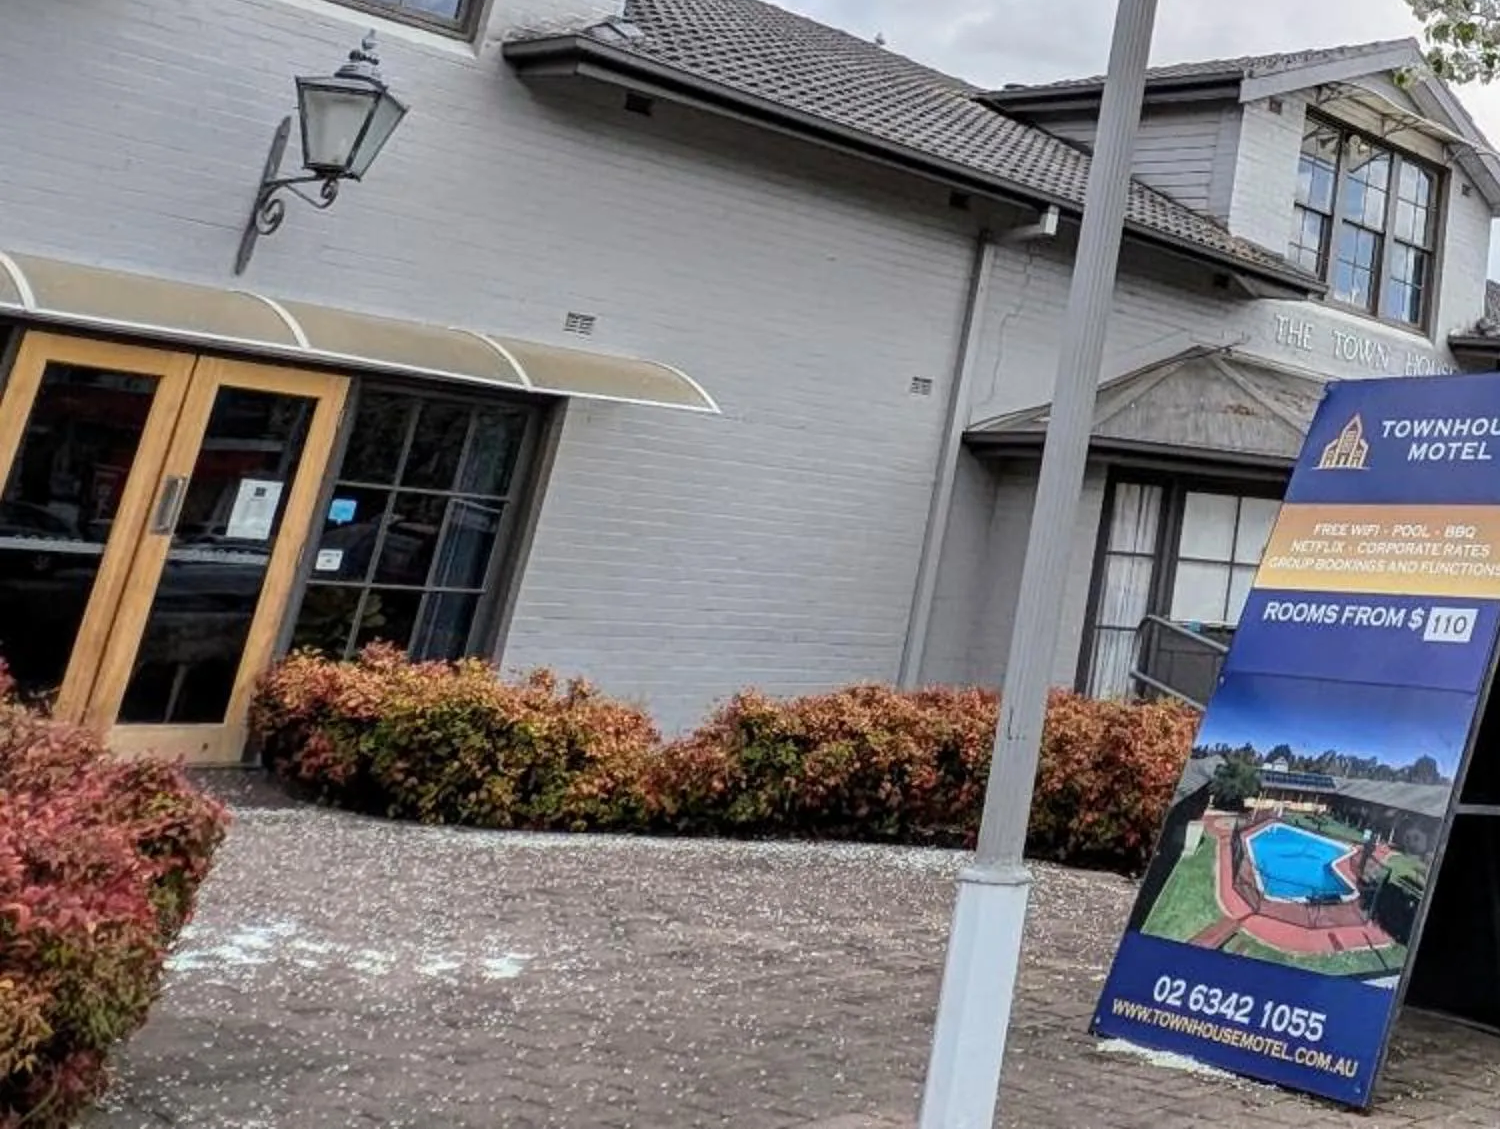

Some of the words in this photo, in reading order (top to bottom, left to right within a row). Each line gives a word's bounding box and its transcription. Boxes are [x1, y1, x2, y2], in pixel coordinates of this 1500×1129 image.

[1274, 313, 1315, 352] THE
[1332, 329, 1391, 370] TOWN
[1407, 442, 1492, 461] MOTEL
[1313, 523, 1349, 537] FREE
[1351, 524, 1381, 537] WIFI
[1392, 524, 1431, 538] POOL
[1444, 525, 1478, 540] BBQ
[1290, 540, 1346, 554] NETFLIX
[1357, 542, 1443, 557] CORPORATE
[1443, 543, 1491, 559] RATES
[1269, 556, 1316, 569] GROUP
[1315, 557, 1386, 572] BOOKINGS
[1384, 560, 1419, 572] AND
[1263, 601, 1339, 625] ROOMS
[1341, 606, 1405, 629] FROM
[1153, 976, 1185, 1007] 02
[1188, 984, 1255, 1025] 6342
[1259, 1000, 1327, 1041] 1055
[1112, 998, 1358, 1078] WWW.TOWNHOUSEMOTEL.COM.AU
